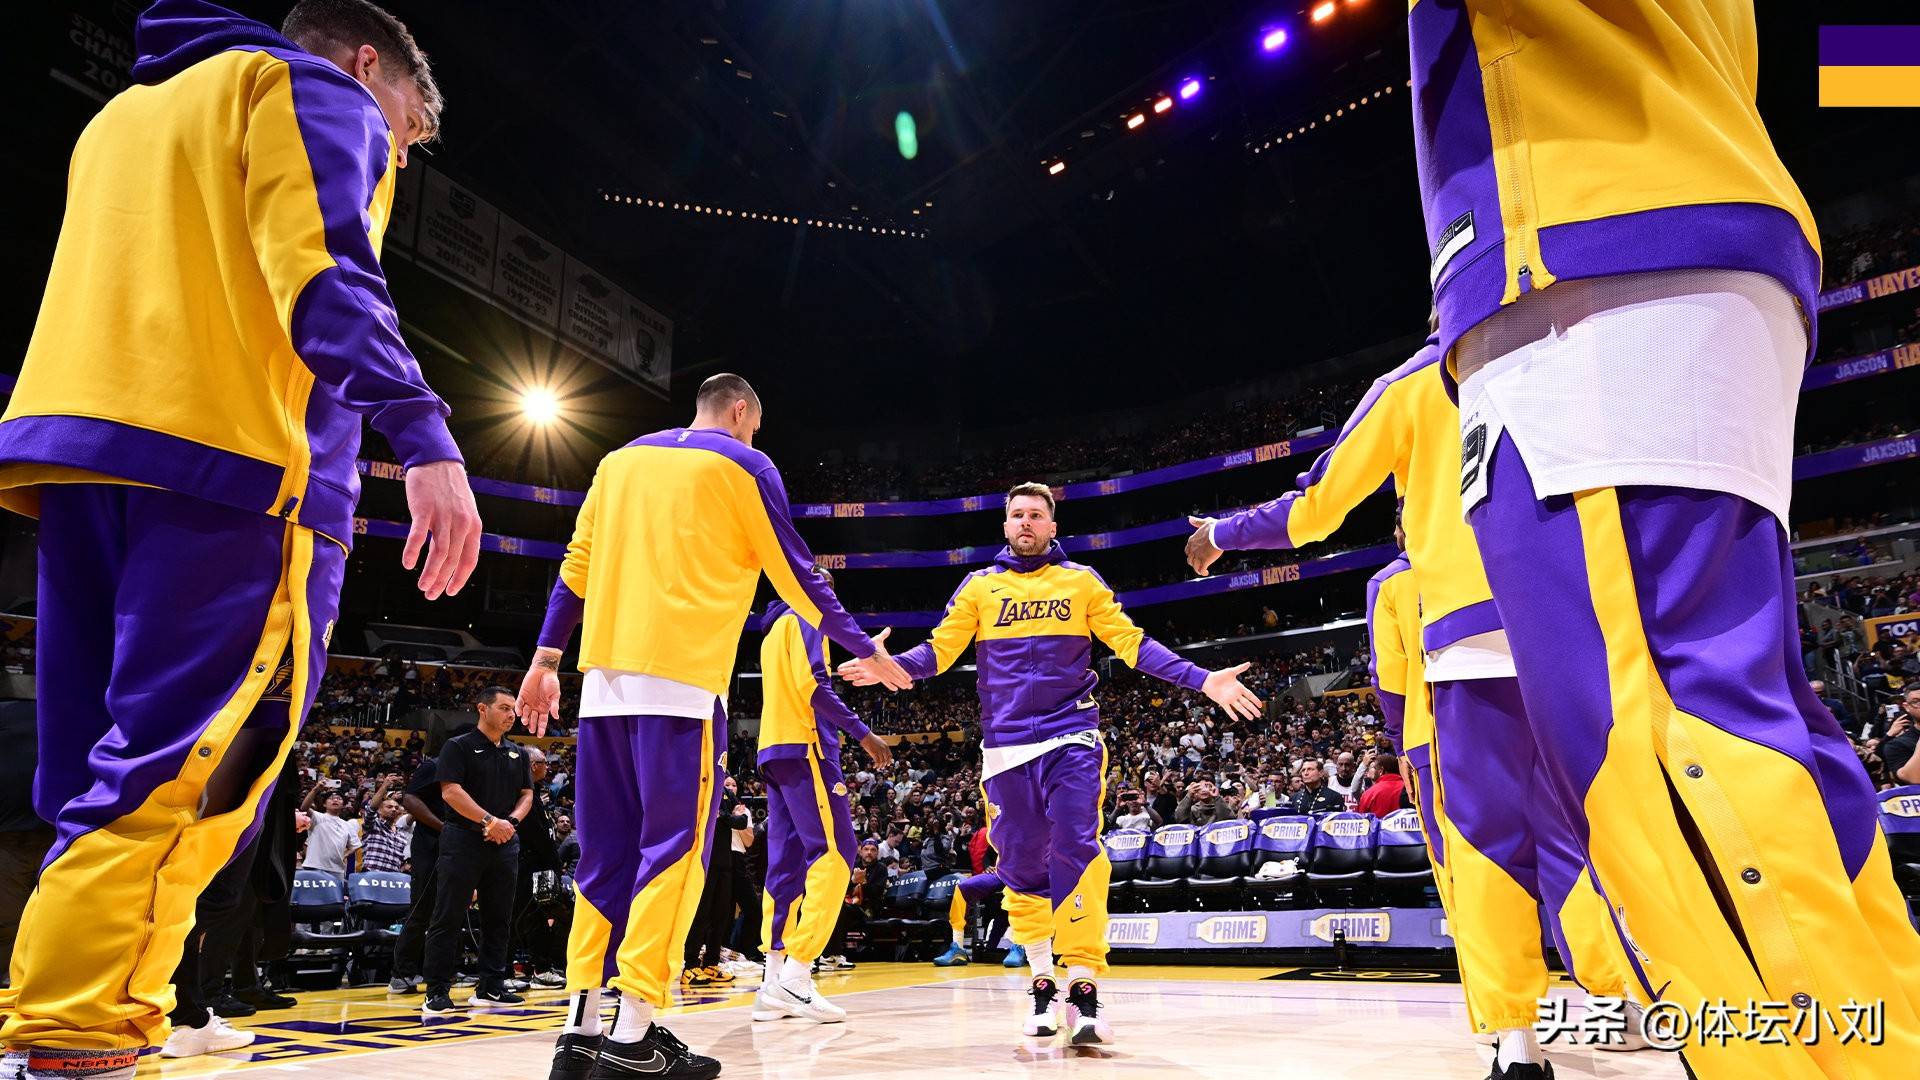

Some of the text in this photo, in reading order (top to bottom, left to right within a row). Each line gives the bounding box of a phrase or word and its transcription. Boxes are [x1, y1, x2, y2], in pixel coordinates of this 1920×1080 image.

[69, 29, 131, 69] CHAM
[426, 215, 490, 258] CONFERENCE
[428, 227, 488, 268] CHAMPIONS
[500, 258, 558, 298] CONFERENCE
[1819, 265, 1920, 308] AXSON HAYE
[502, 270, 553, 305] CHAMPIONS
[1835, 355, 1888, 379] JAXSON
[1223, 441, 1291, 467] JAXSON HAYES
[1862, 439, 1917, 462] JAXSON
[805, 503, 865, 517] JAXSON HAYES
[814, 554, 847, 569] HAYES
[1229, 564, 1300, 587] JAXSON HAYES
[993, 598, 1072, 627] LAKERS
[1273, 825, 1301, 837] PRIME
[1333, 821, 1364, 834] PRIME
[1393, 818, 1420, 830] PRIM
[1116, 836, 1140, 848] PRIME
[1164, 832, 1189, 844] PRIME
[1217, 827, 1243, 841] PRIME
[293, 880, 337, 888] DELTA
[371, 879, 411, 889] DELTA
[895, 877, 919, 886] DELTA
[935, 879, 961, 888] DELTA
[1109, 922, 1151, 940] PRIME
[1213, 921, 1258, 940] PRIME
[1329, 918, 1380, 938] PRIME
[63, 1058, 108, 1069] NBA
